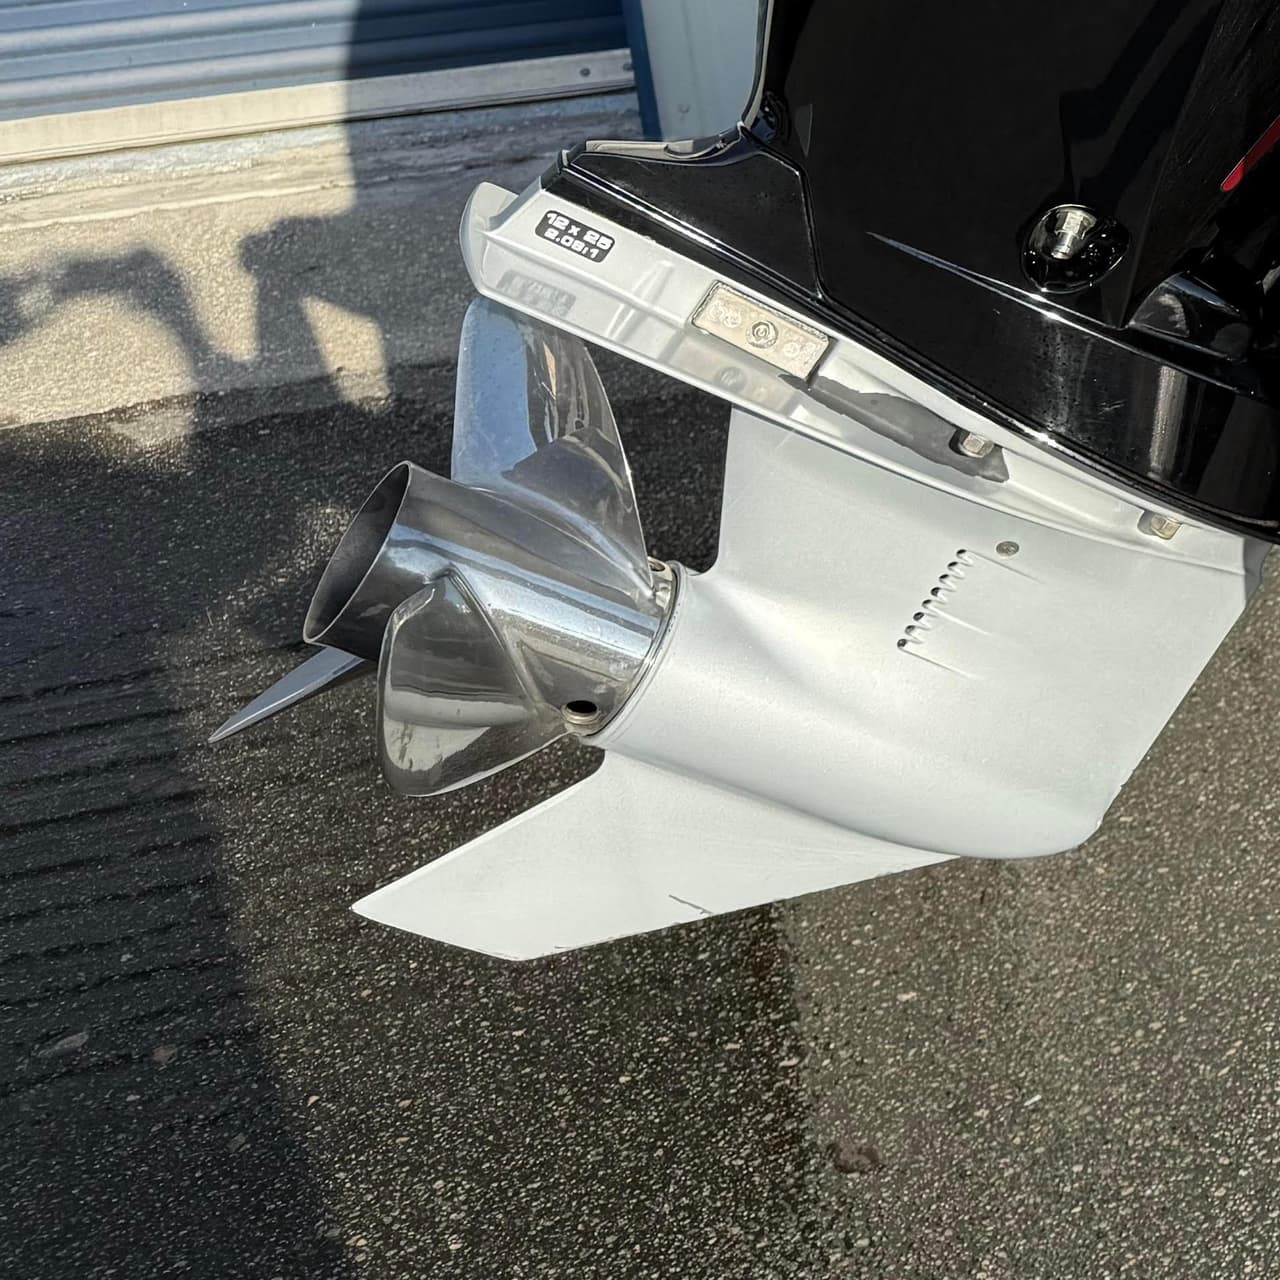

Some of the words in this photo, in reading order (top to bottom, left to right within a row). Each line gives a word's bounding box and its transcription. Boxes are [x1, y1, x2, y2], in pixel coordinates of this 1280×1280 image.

[544, 228, 600, 259] 2.08:1
[546, 213, 570, 230] 12
[583, 230, 613, 250] 25
